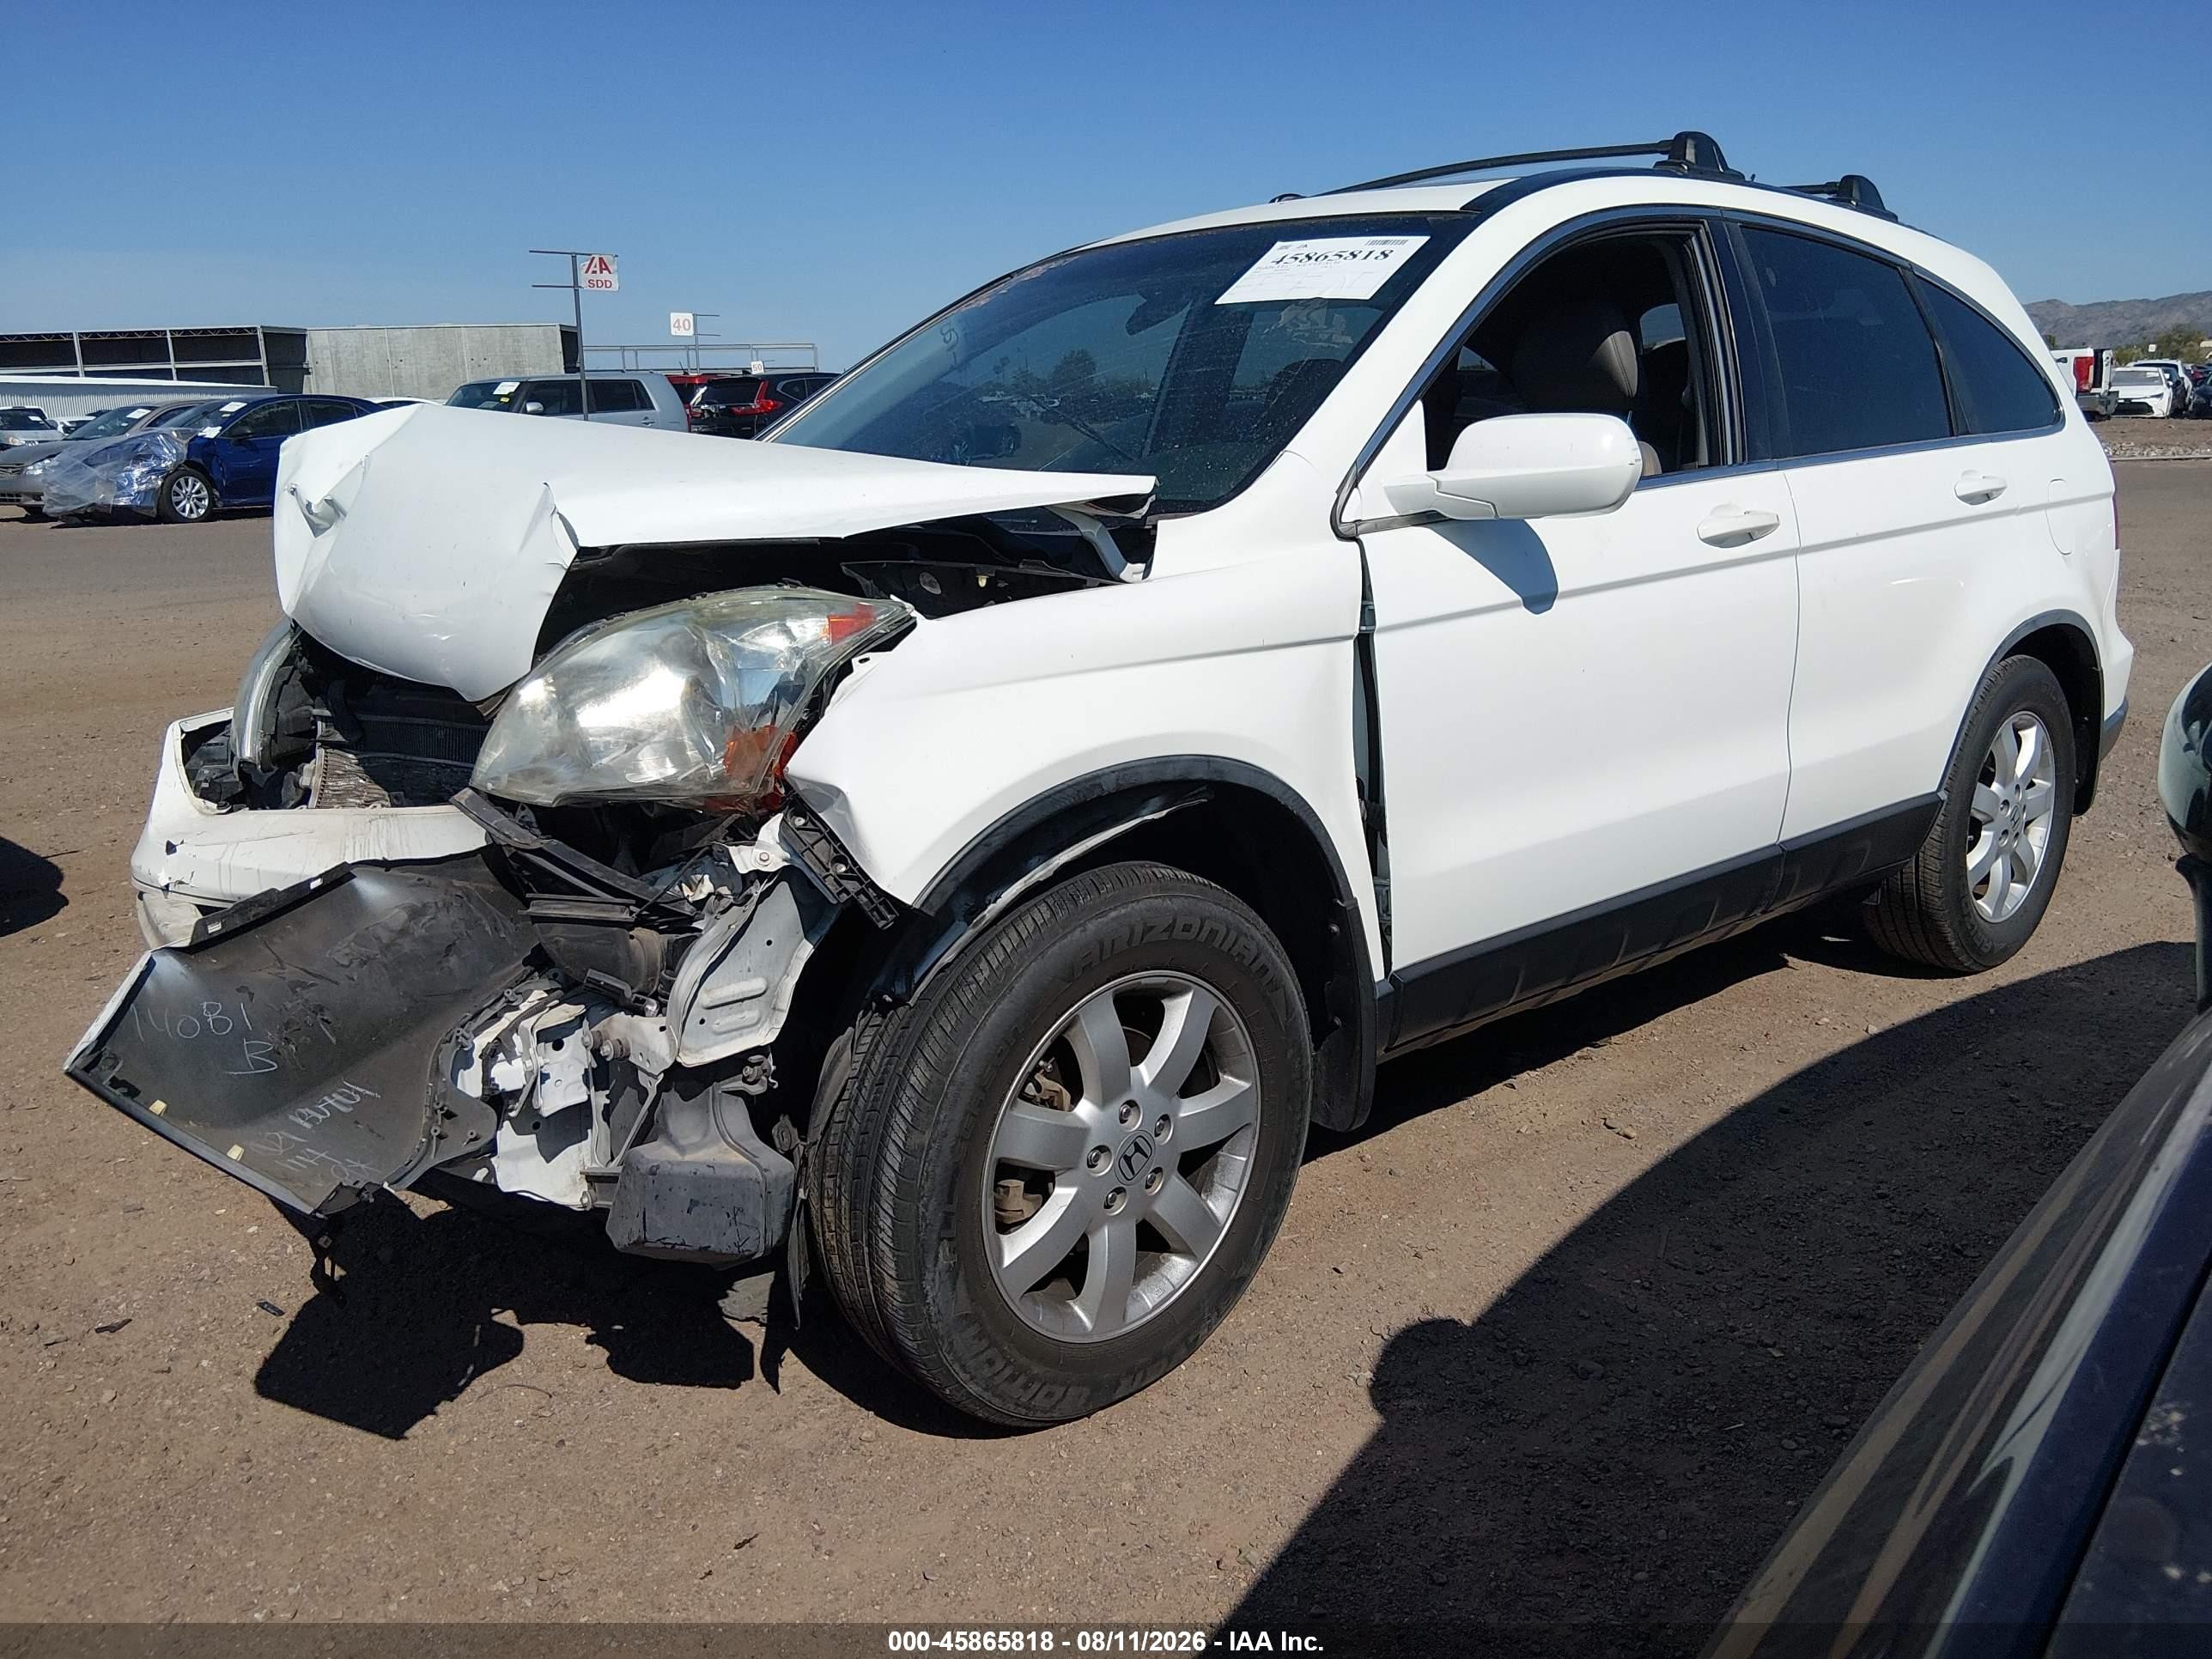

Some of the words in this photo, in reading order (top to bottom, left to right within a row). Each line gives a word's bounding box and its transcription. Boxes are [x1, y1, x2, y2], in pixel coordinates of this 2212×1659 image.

[1271, 249, 1395, 265] 45865818
[587, 279, 613, 289] SDD
[672, 318, 691, 331] 40
